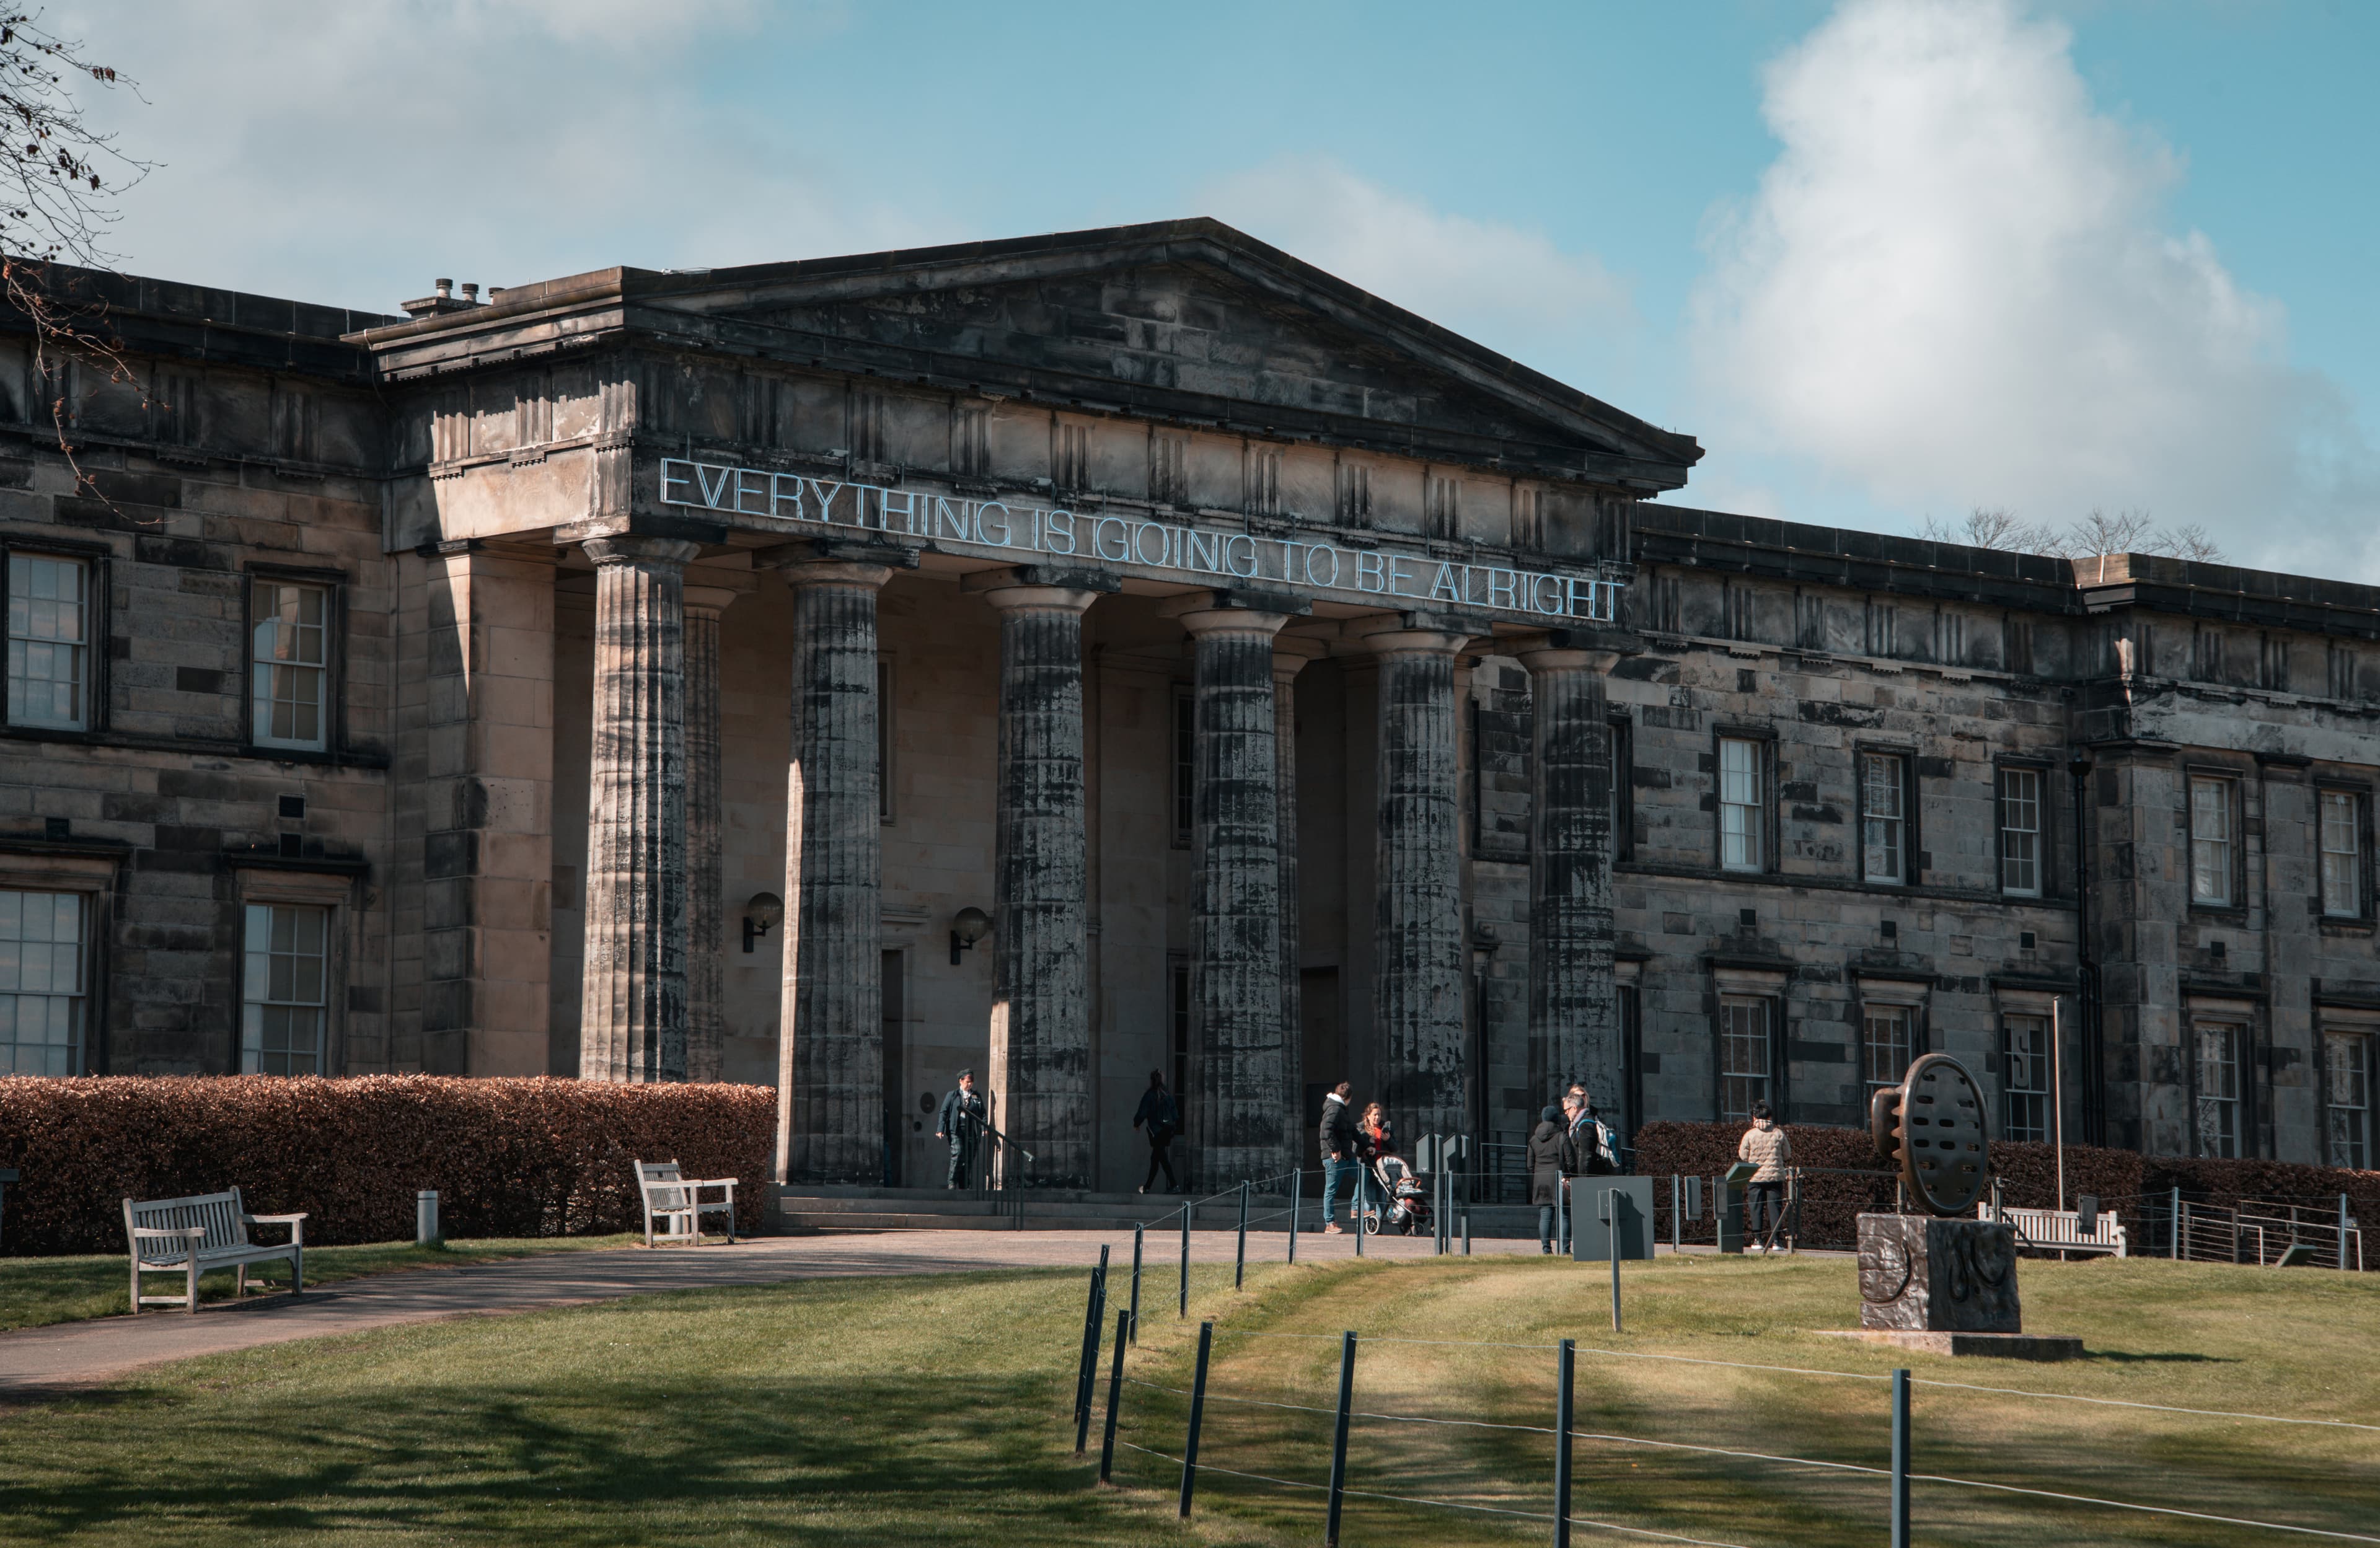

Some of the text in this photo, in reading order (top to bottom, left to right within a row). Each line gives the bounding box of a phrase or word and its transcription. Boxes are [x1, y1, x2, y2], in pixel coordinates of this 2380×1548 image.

[661, 458, 1624, 622] EVERYTHING IS GOING TO BE ALRIGHT
